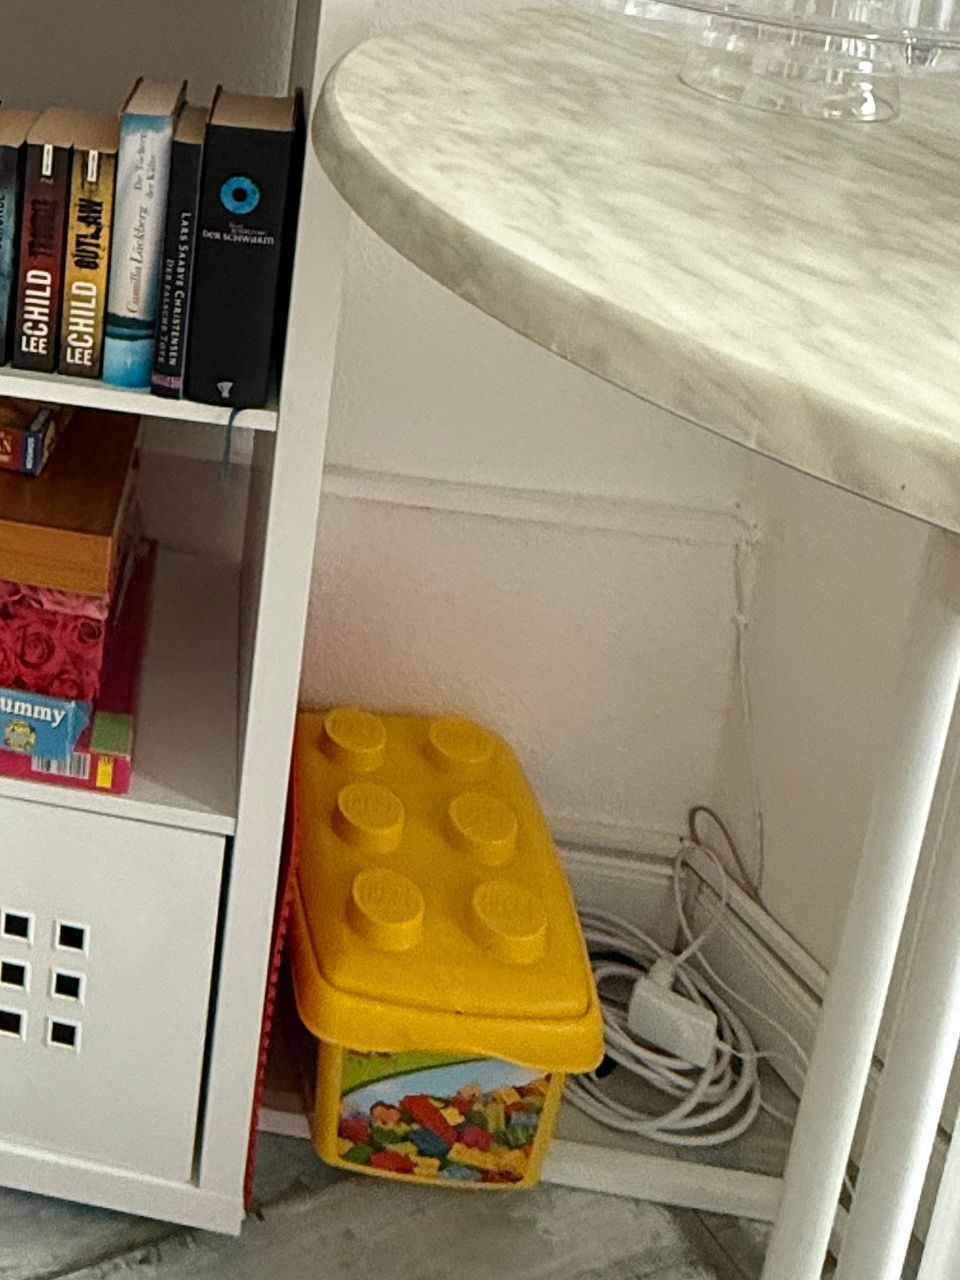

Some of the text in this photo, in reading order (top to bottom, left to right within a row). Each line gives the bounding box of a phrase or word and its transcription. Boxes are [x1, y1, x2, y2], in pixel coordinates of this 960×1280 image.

[22, 269, 52, 336] CHILD
[65, 197, 103, 366] LEE CHILD OUTLAW
[167, 212, 192, 366] LARS SAABYE CHRISTENSEN
[20, 335, 48, 355] LEE
